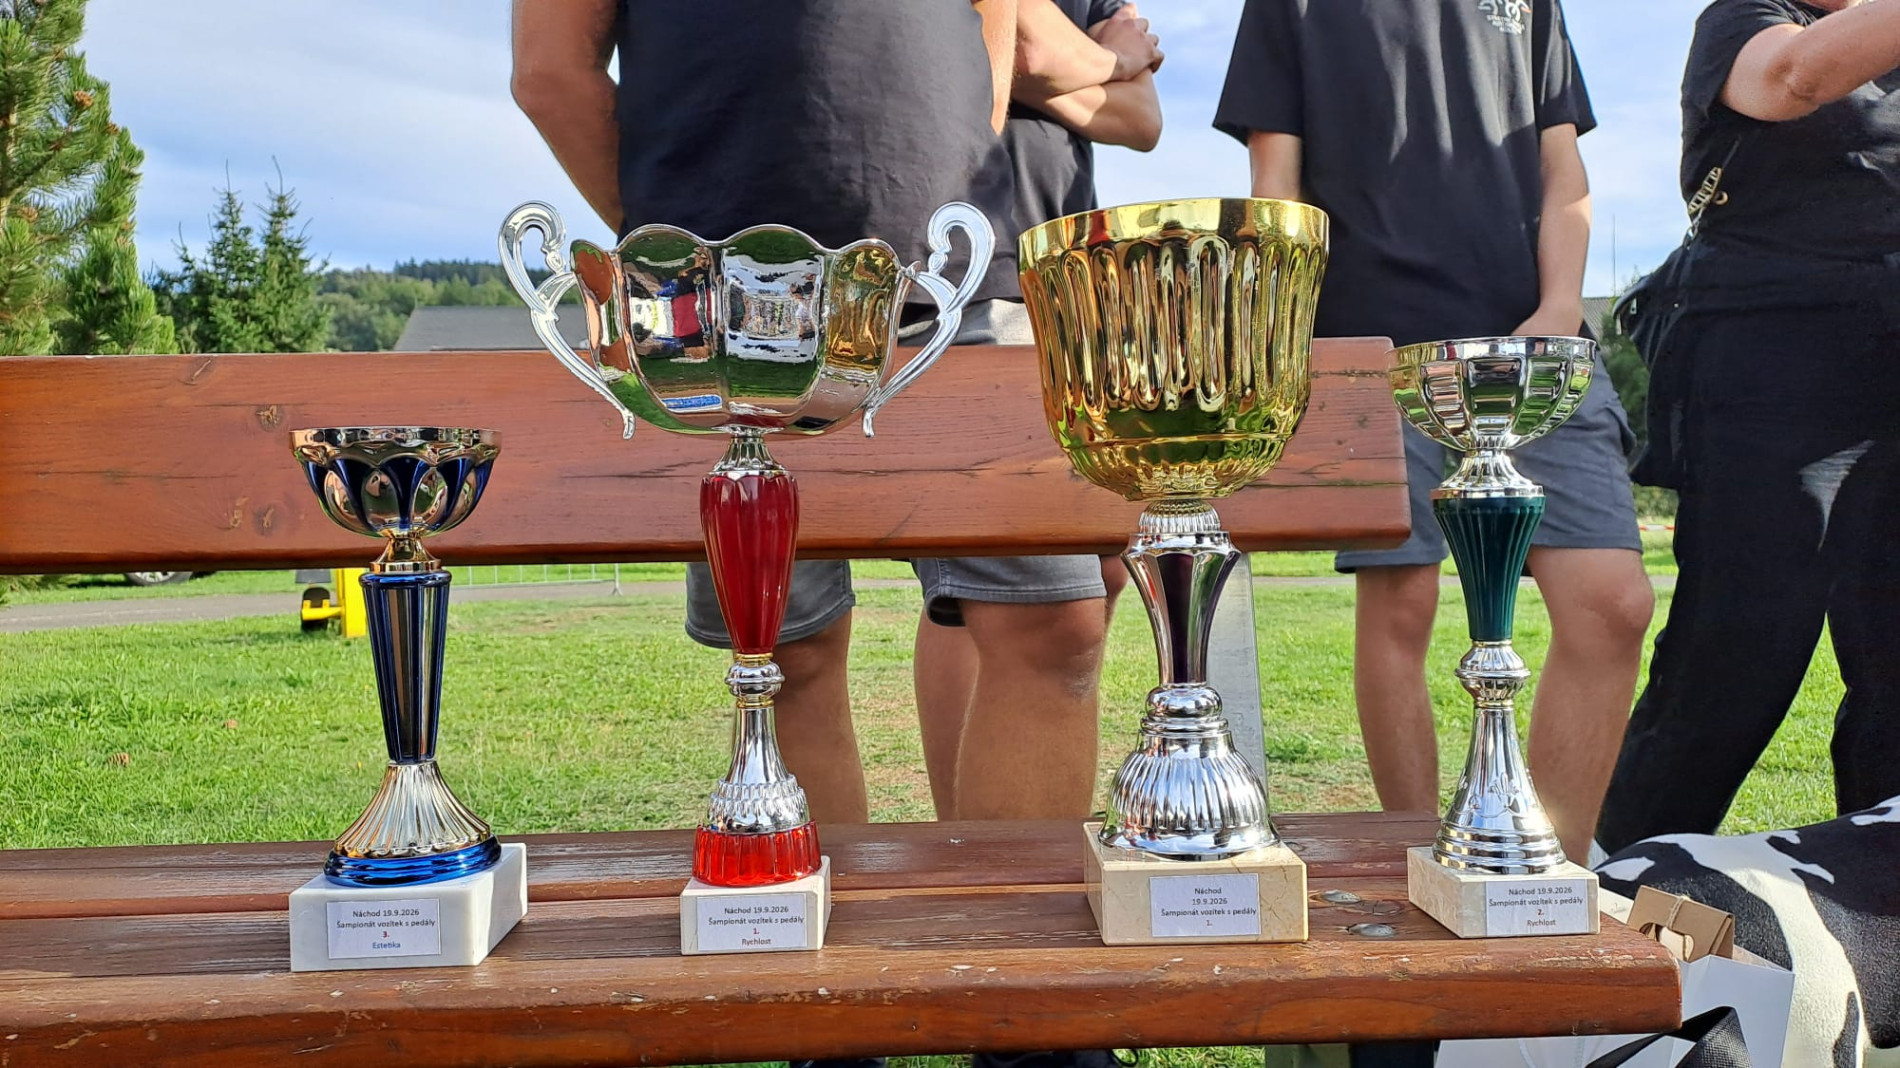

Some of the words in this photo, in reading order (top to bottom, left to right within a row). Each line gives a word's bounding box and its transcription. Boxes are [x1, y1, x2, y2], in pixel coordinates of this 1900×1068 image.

[1489, 899, 1526, 907] Šampionát
[1560, 897, 1583, 905] pedály
[1161, 908, 1199, 916] Šampionát
[337, 921, 375, 929] Šampionát
[411, 919, 435, 927] pedály
[708, 918, 746, 926] Šampionát
[780, 916, 804, 924] pedály
[1527, 919, 1556, 927] Rychlost
[742, 938, 771, 946] Rychlost
